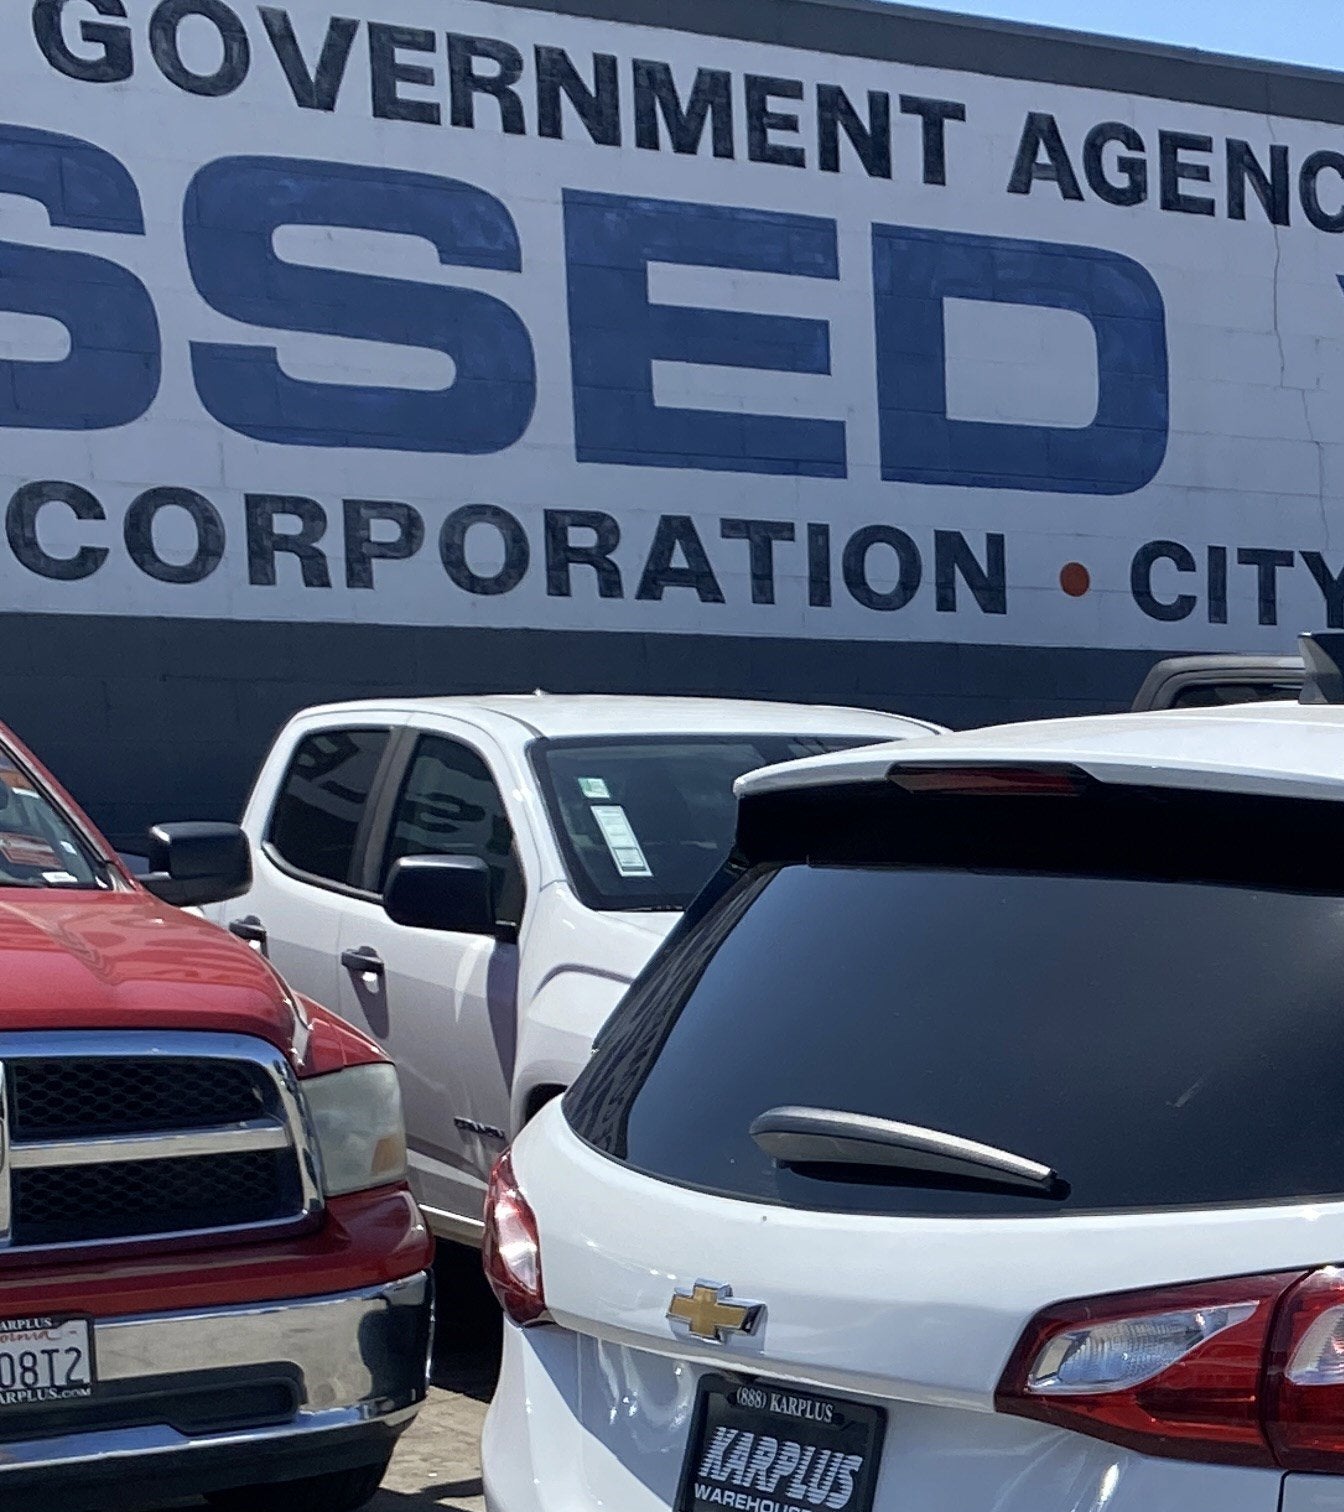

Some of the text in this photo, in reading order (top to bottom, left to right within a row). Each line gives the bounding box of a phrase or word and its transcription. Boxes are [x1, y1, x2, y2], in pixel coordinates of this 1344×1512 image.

[32, 0, 966, 187] GOVERNMENT
[5, 480, 1007, 615] CORPORATION
[736, 1386, 835, 1424] (888) KARPLUS
[698, 1426, 864, 1510] KARPLUS
